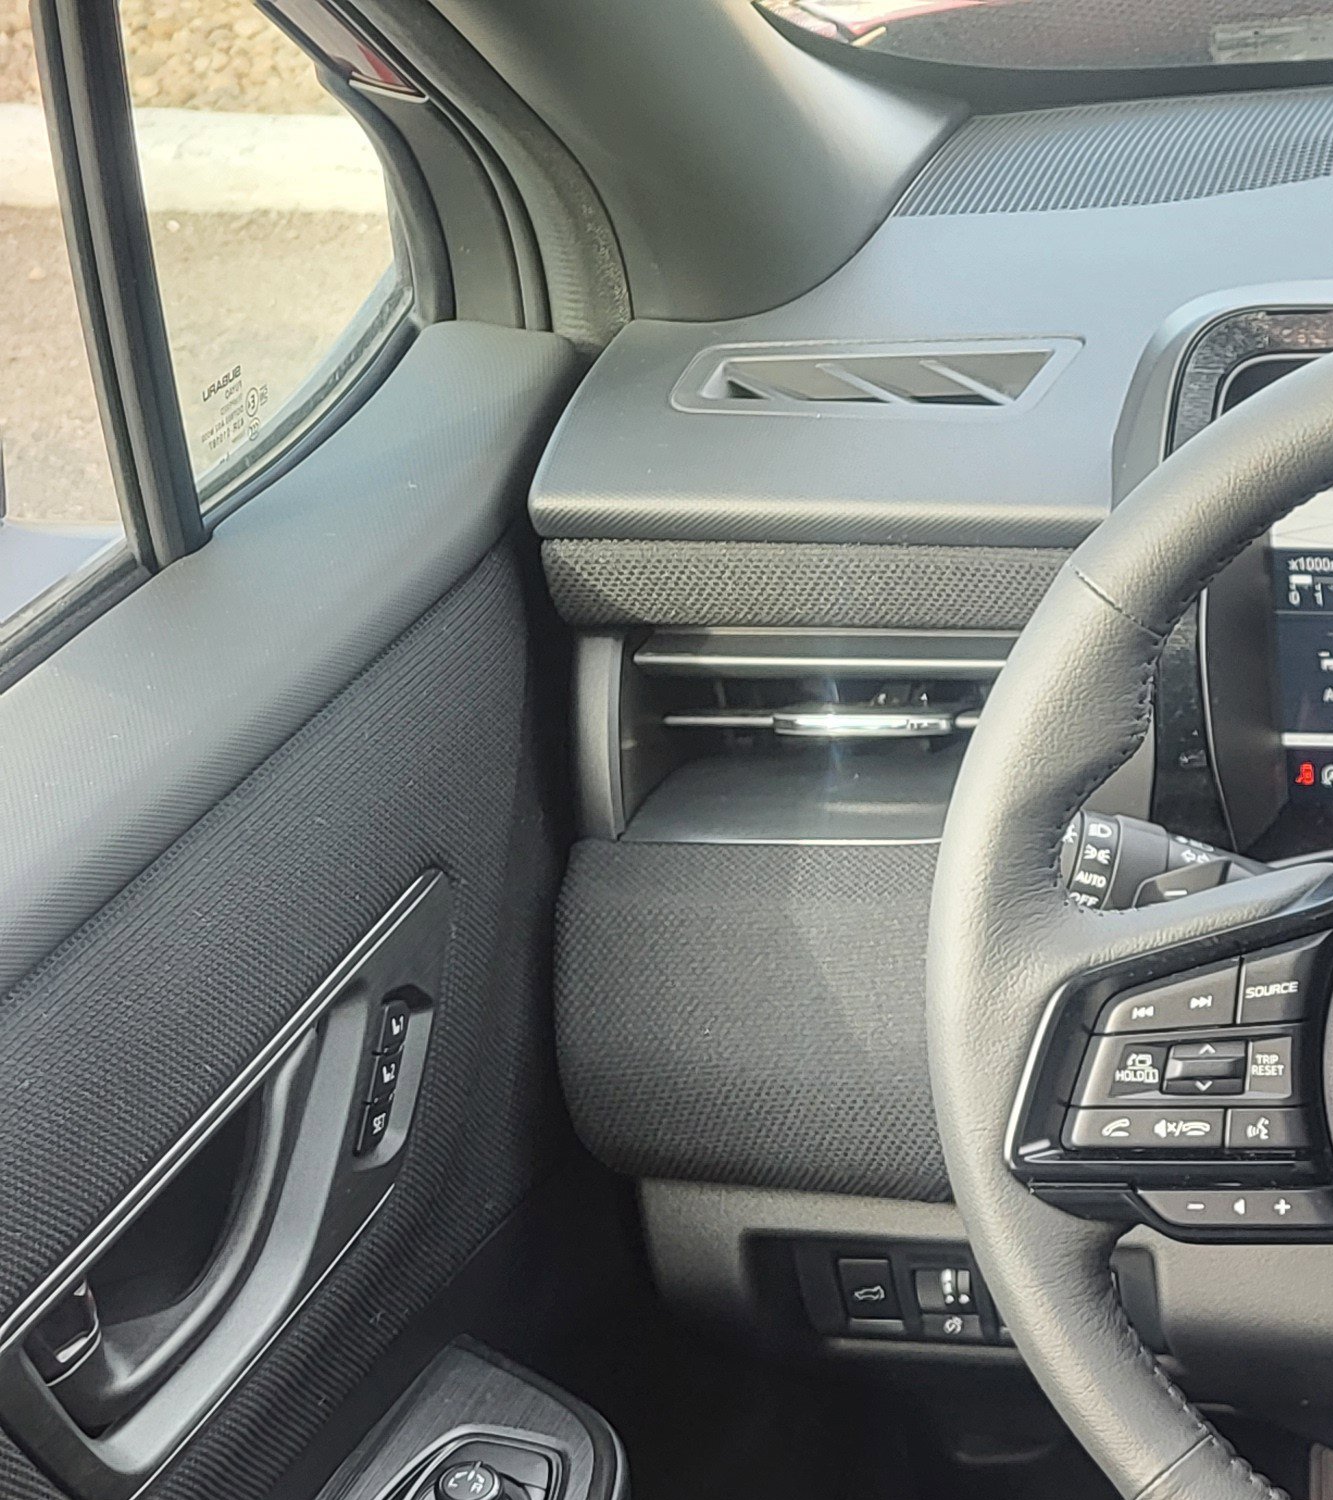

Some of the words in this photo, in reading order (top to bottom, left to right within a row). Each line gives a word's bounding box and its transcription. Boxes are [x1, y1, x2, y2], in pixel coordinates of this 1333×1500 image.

[1288, 592, 1300, 610] 0
[1314, 592, 1324, 610] 1
[1075, 870, 1107, 888] AUTO
[1245, 981, 1299, 999] SOURCE
[1255, 1054, 1279, 1065] TRIP
[1115, 1069, 1144, 1082] HOLD
[1251, 1064, 1284, 1076] RESET
